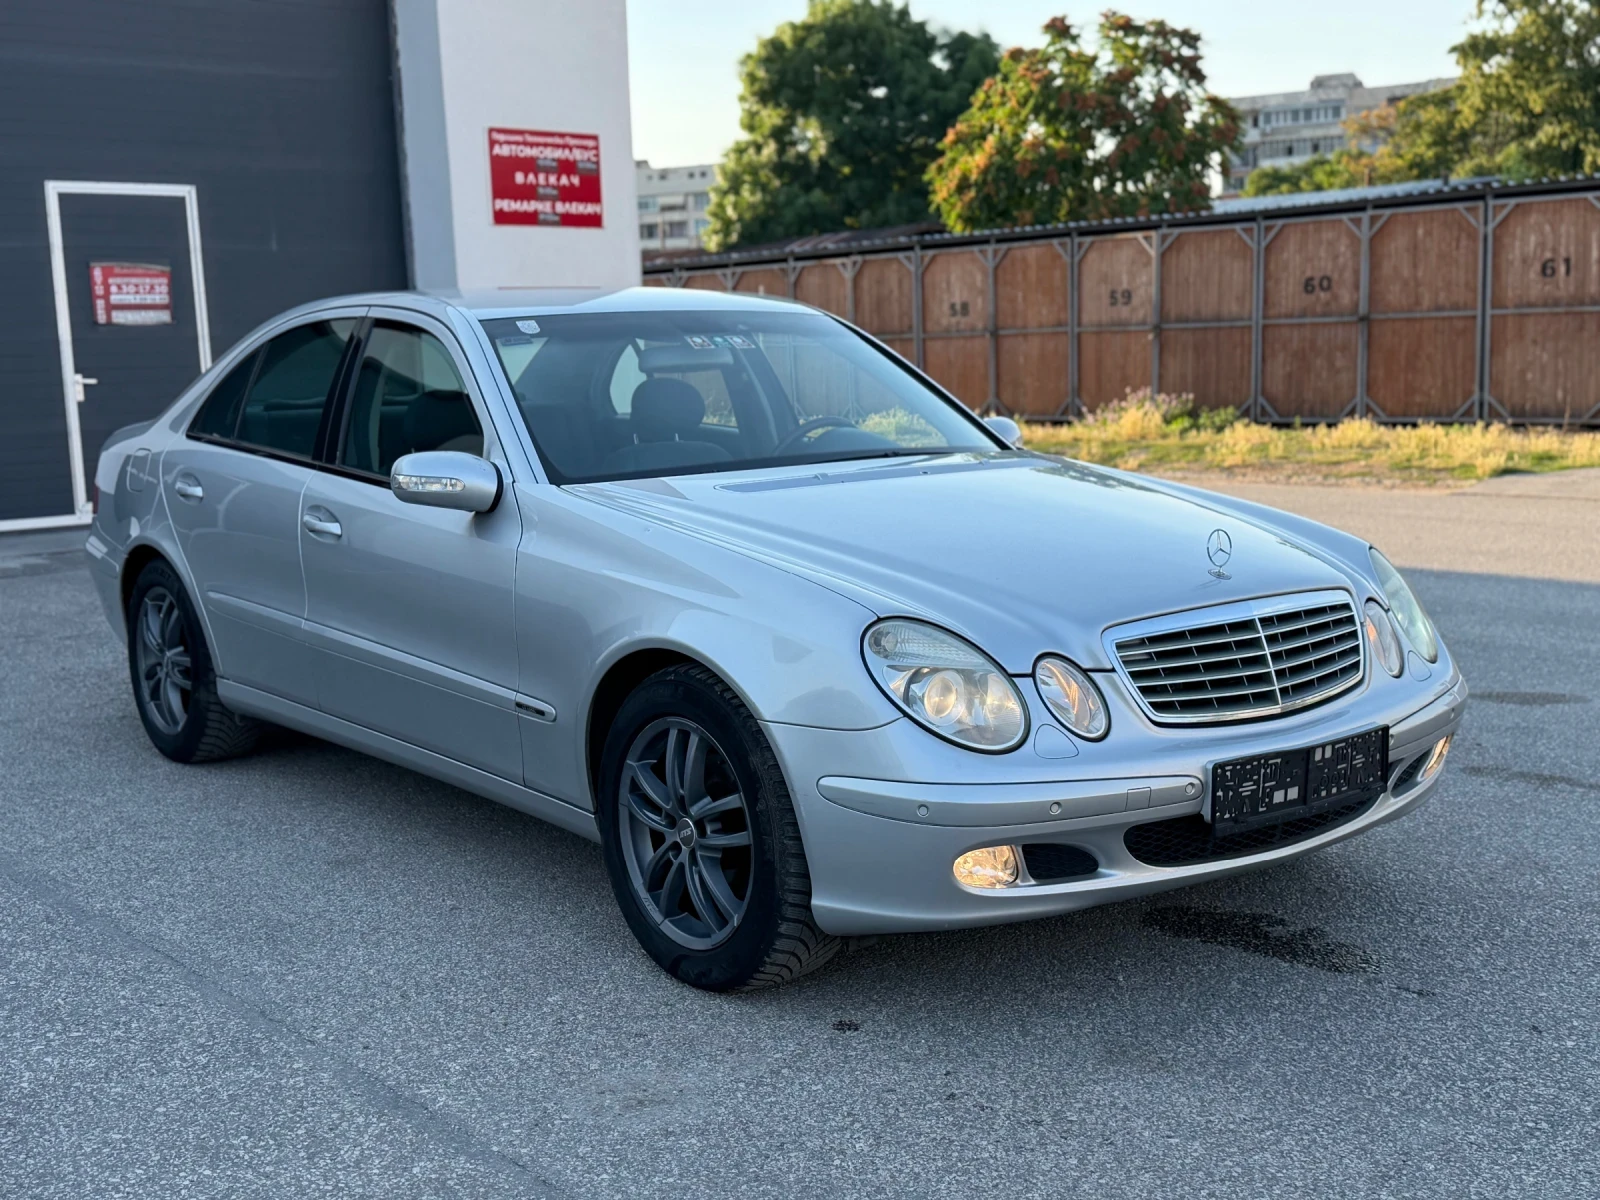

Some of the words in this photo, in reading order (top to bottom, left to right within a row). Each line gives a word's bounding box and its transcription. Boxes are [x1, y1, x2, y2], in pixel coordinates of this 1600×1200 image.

[515, 171, 579, 186] ВЛЕКАЧ
[494, 199, 554, 212] РЕМАРКЕ
[554, 201, 602, 215] ВЛЕКАЧ
[1541, 257, 1571, 278] 61
[1303, 275, 1332, 294] 60
[1109, 289, 1132, 306] 59
